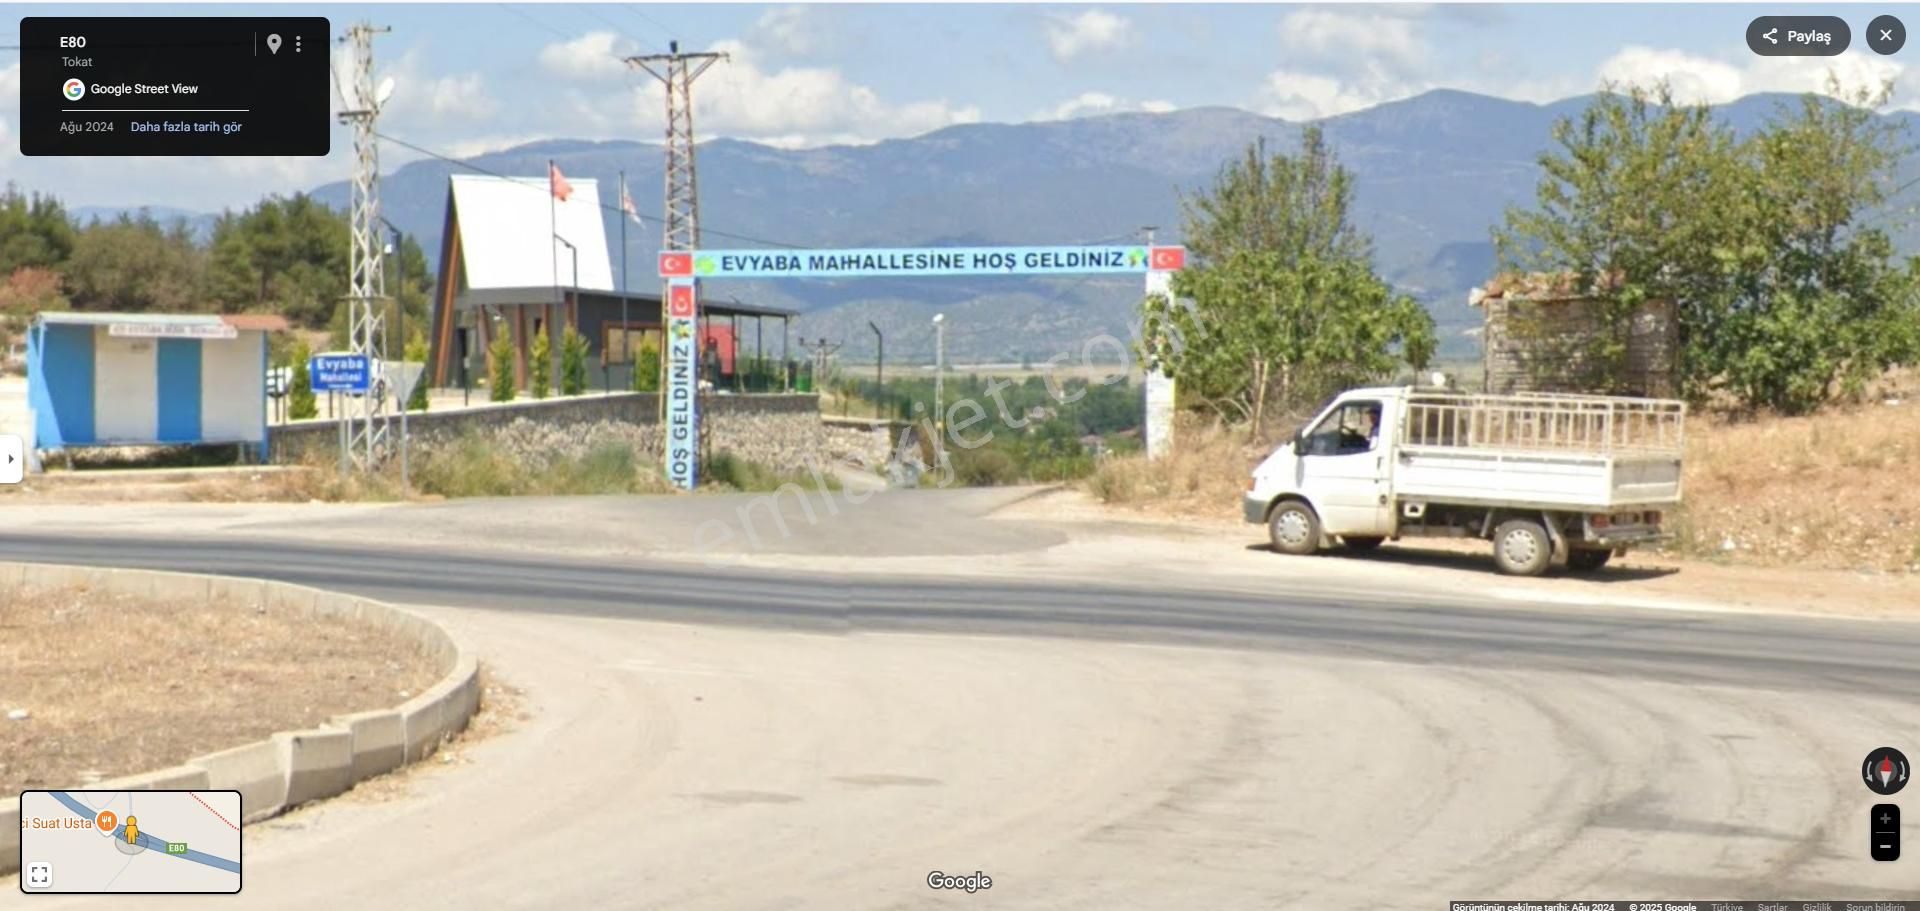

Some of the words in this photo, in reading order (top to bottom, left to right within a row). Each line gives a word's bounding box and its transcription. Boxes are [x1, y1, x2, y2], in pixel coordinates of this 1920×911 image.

[721, 255, 802, 271] EVYABA
[973, 253, 1017, 272] HOŞ
[1024, 249, 1124, 268] GELDİNİZ
[317, 358, 364, 371] Evyaba
[671, 448, 690, 489] HOŞ
